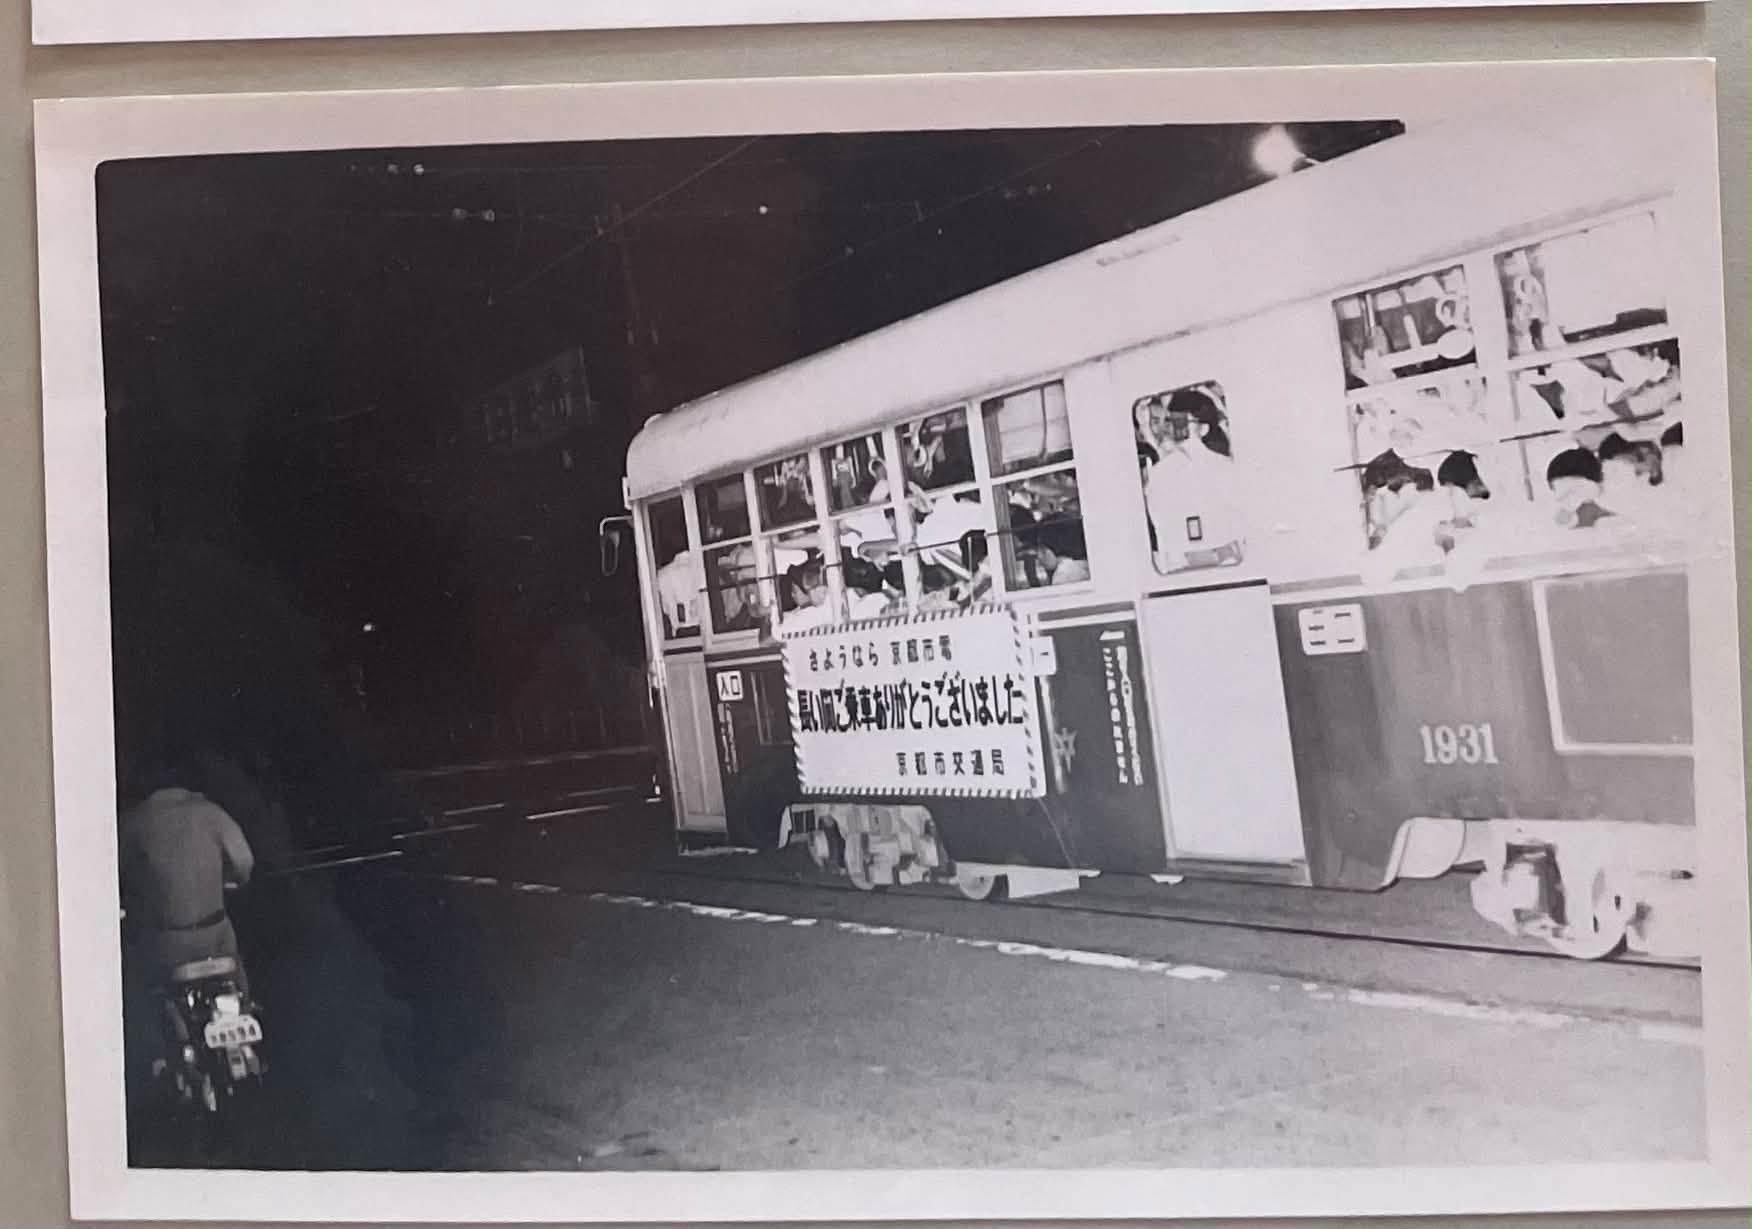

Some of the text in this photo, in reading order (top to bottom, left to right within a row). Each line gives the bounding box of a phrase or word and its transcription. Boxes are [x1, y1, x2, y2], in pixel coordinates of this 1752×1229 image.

[808, 635, 953, 672] さようなら 京都市電
[720, 675, 741, 697] 入口
[797, 670, 1024, 733] 長い間ご乗車ありがとうございました
[896, 748, 1005, 776] 京都市交通局
[1420, 722, 1499, 765] 1931
